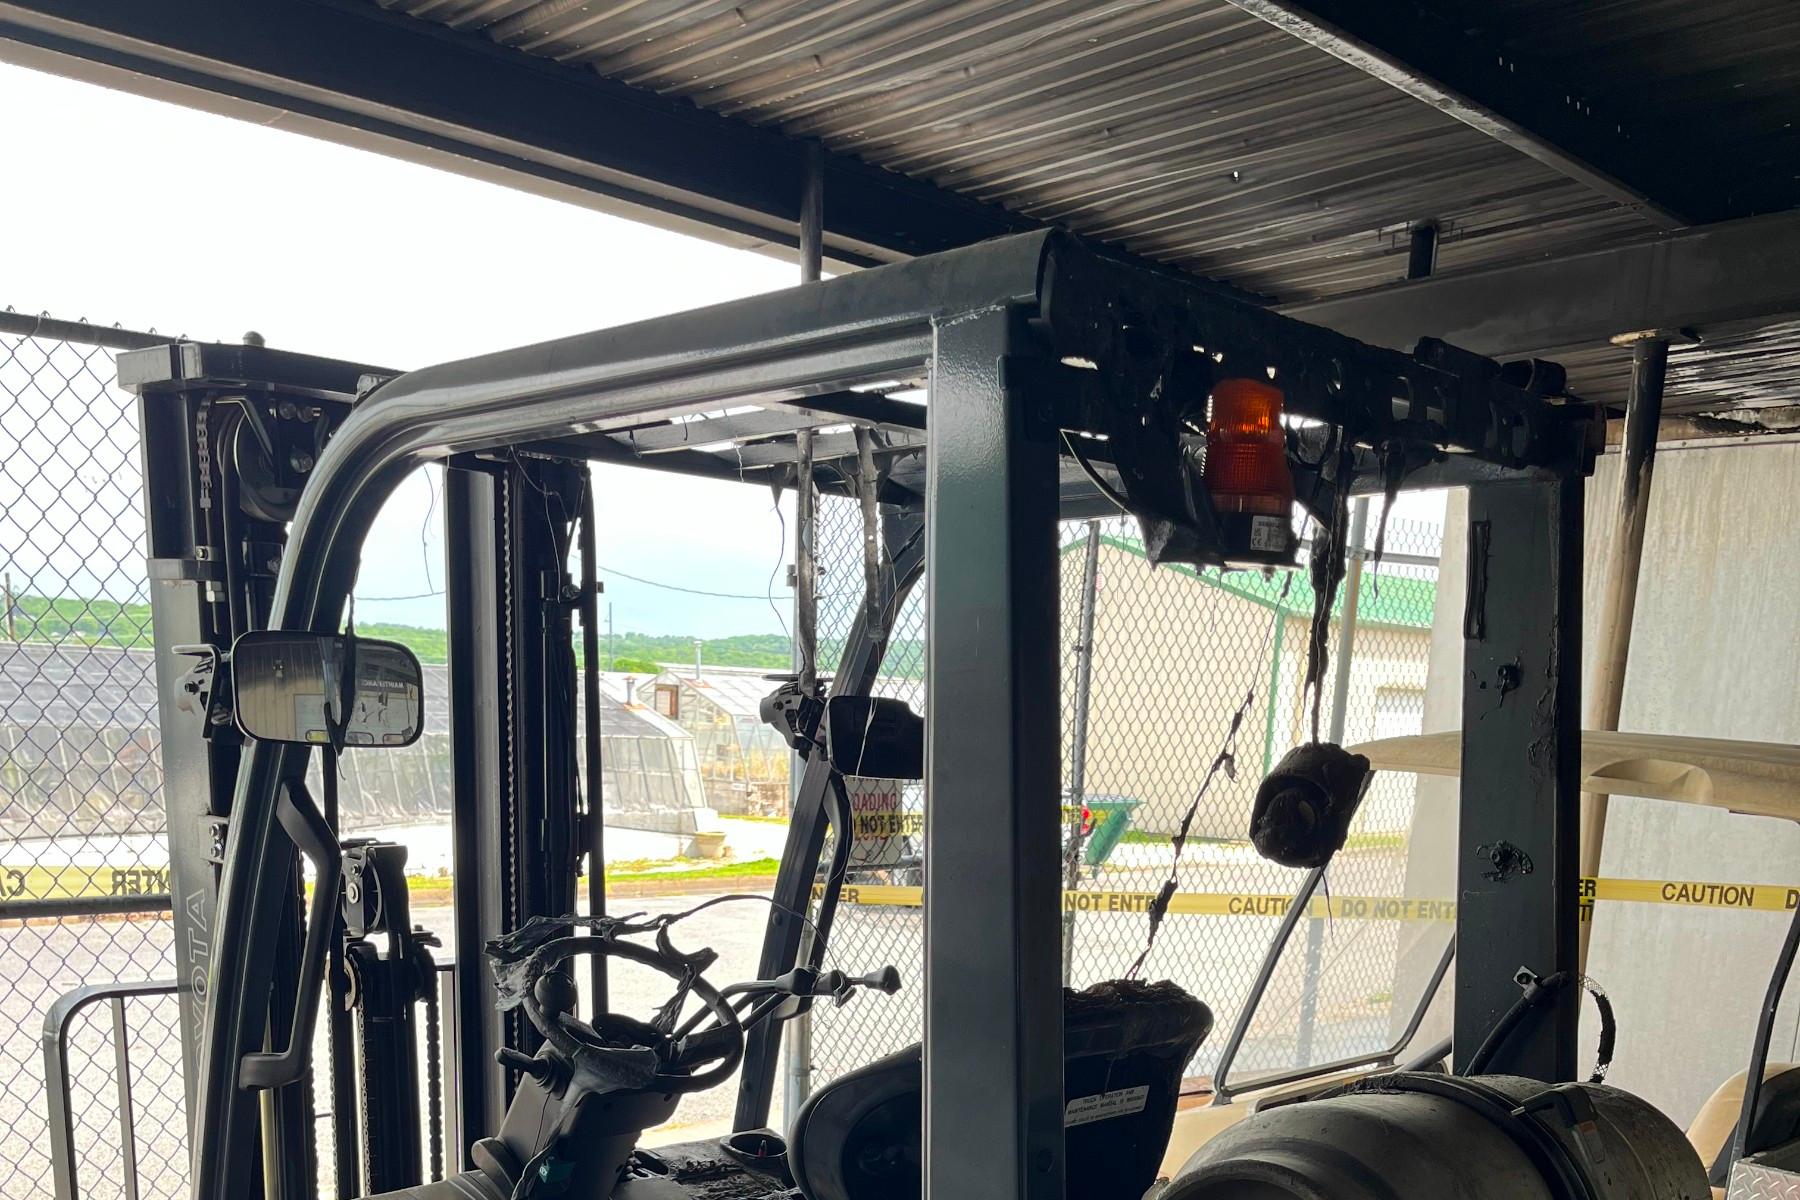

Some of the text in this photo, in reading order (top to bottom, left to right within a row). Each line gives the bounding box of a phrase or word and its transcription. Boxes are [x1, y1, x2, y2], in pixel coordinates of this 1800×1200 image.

[1065, 893, 1103, 911] NOT
[1661, 882, 1755, 907] CAUTION
[1341, 899, 1368, 918] DO
[1374, 900, 1412, 919] NOT
[1417, 900, 1457, 919] ENT
